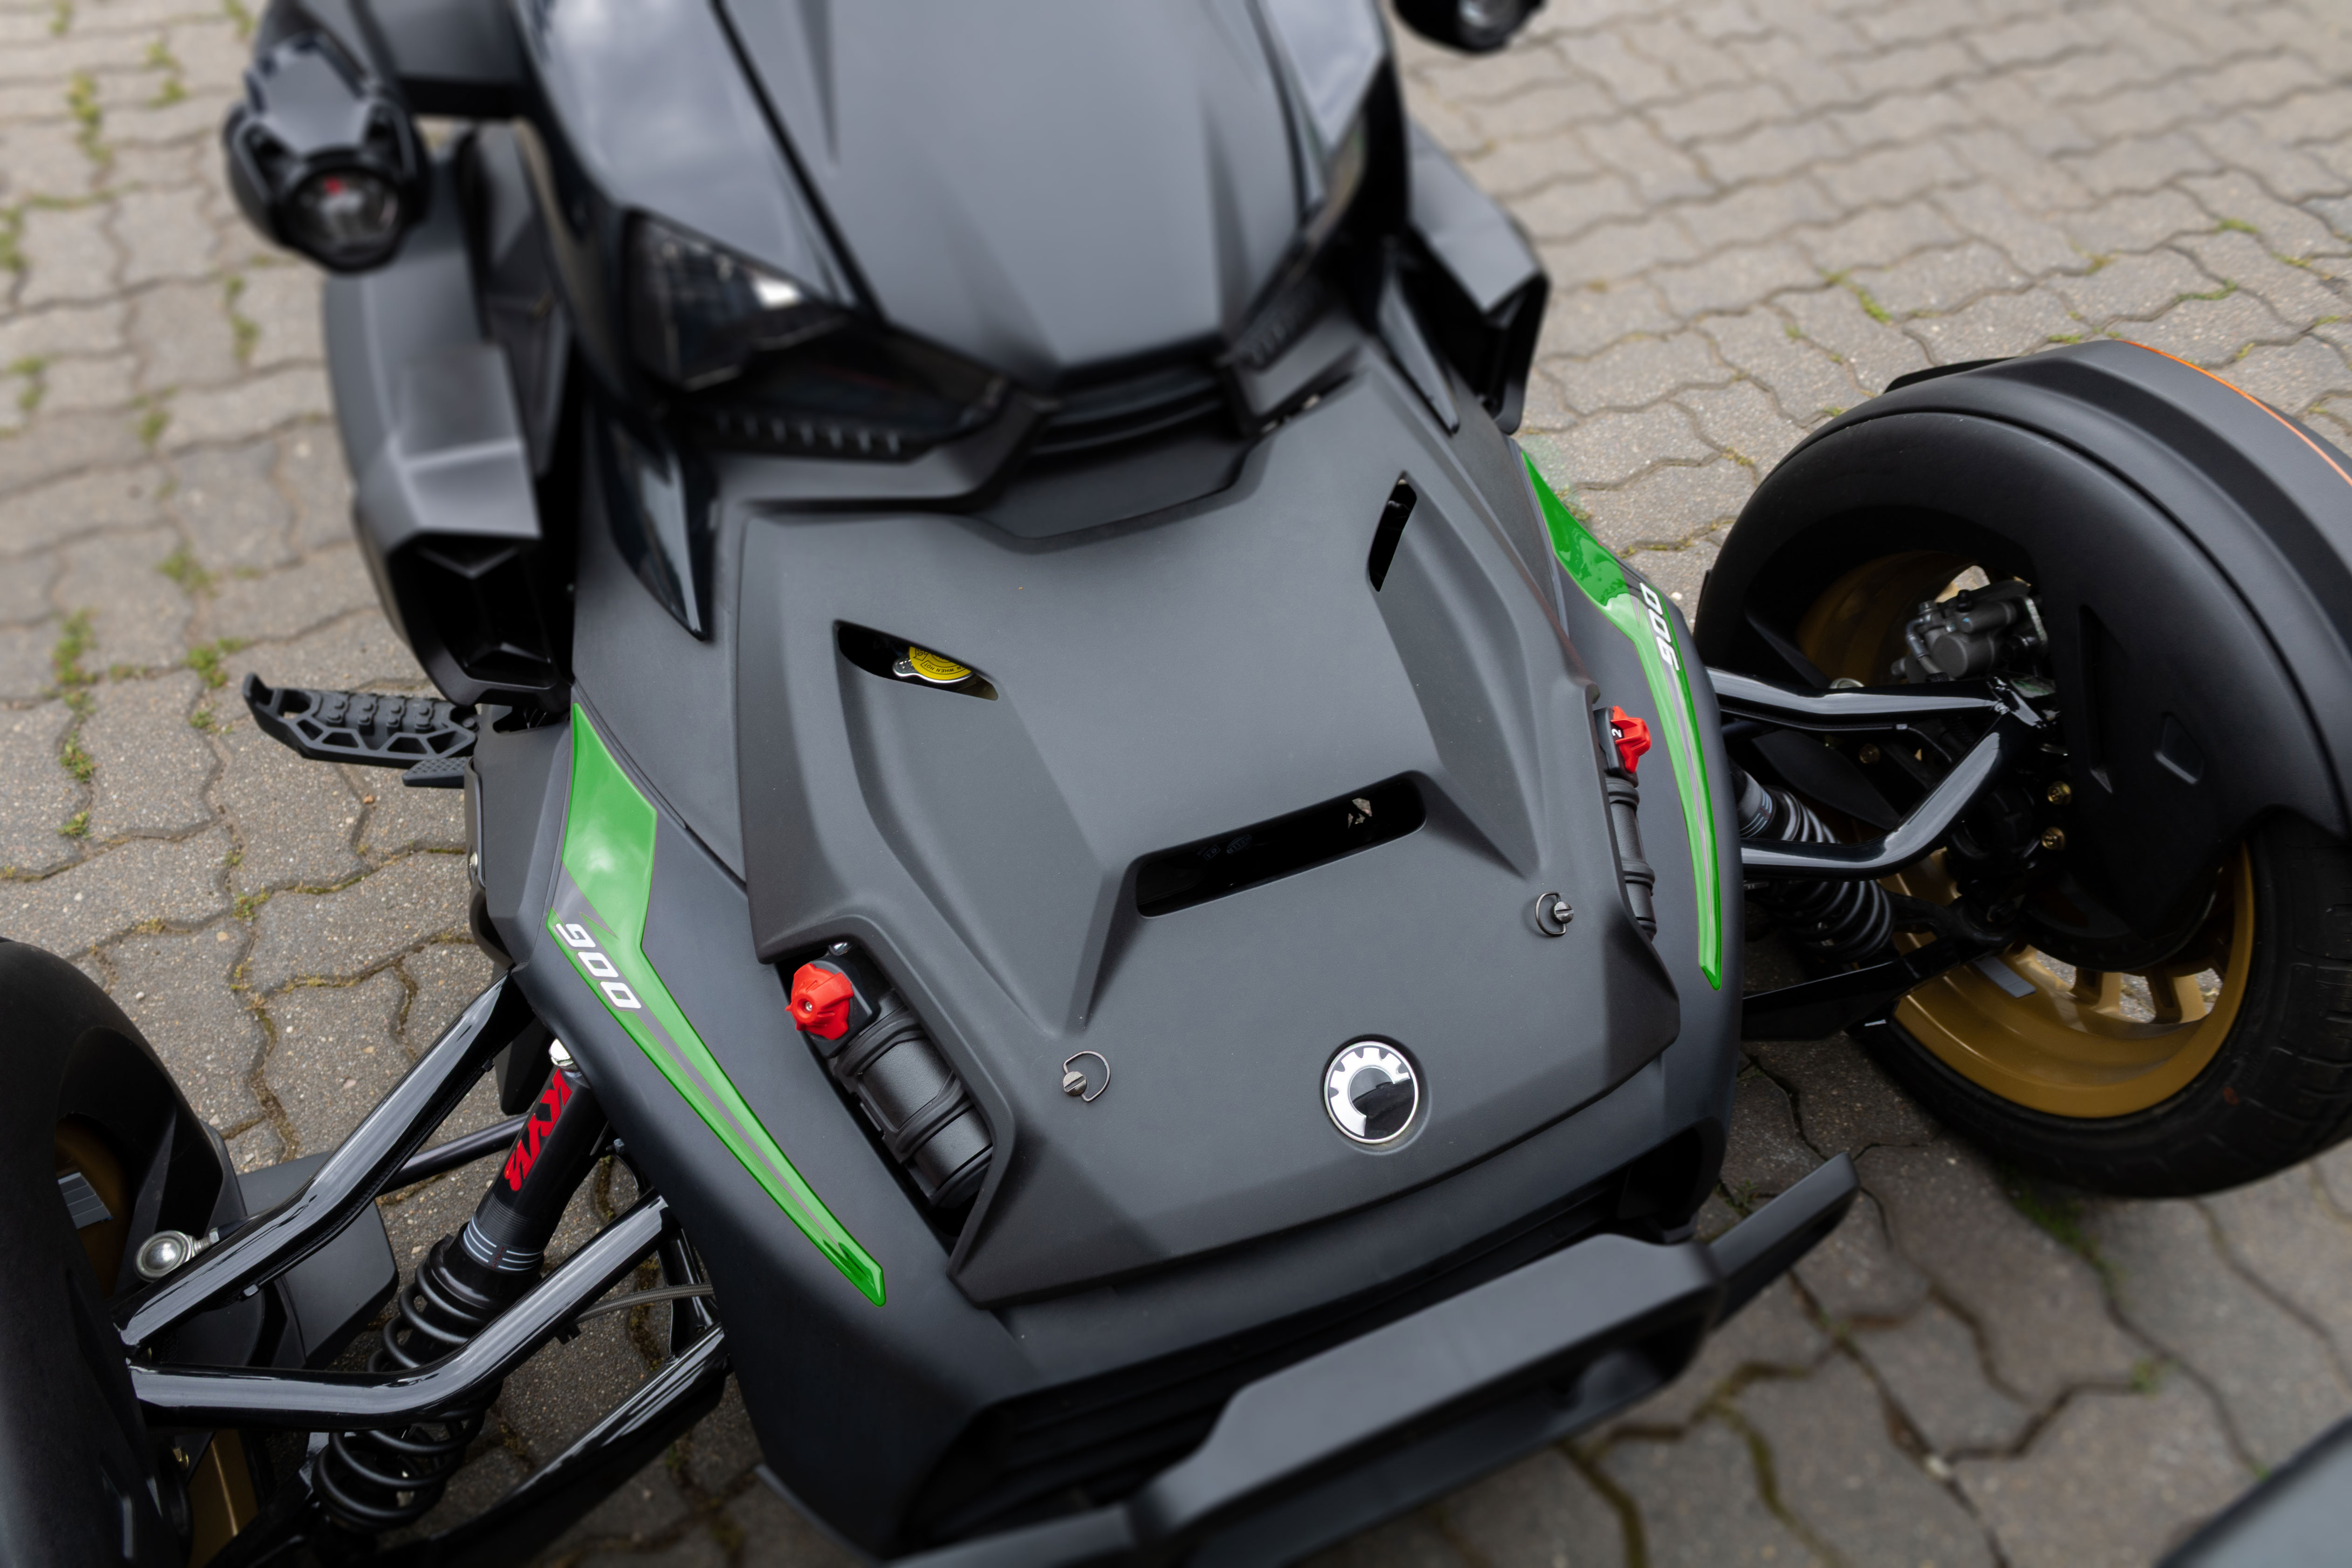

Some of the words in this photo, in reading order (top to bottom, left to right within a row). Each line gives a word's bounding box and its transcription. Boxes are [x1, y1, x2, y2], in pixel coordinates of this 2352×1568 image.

[1639, 582, 1680, 671] 900
[1611, 728, 1622, 738] 2
[556, 923, 642, 1008] 900
[504, 1068, 572, 1191] KYB
